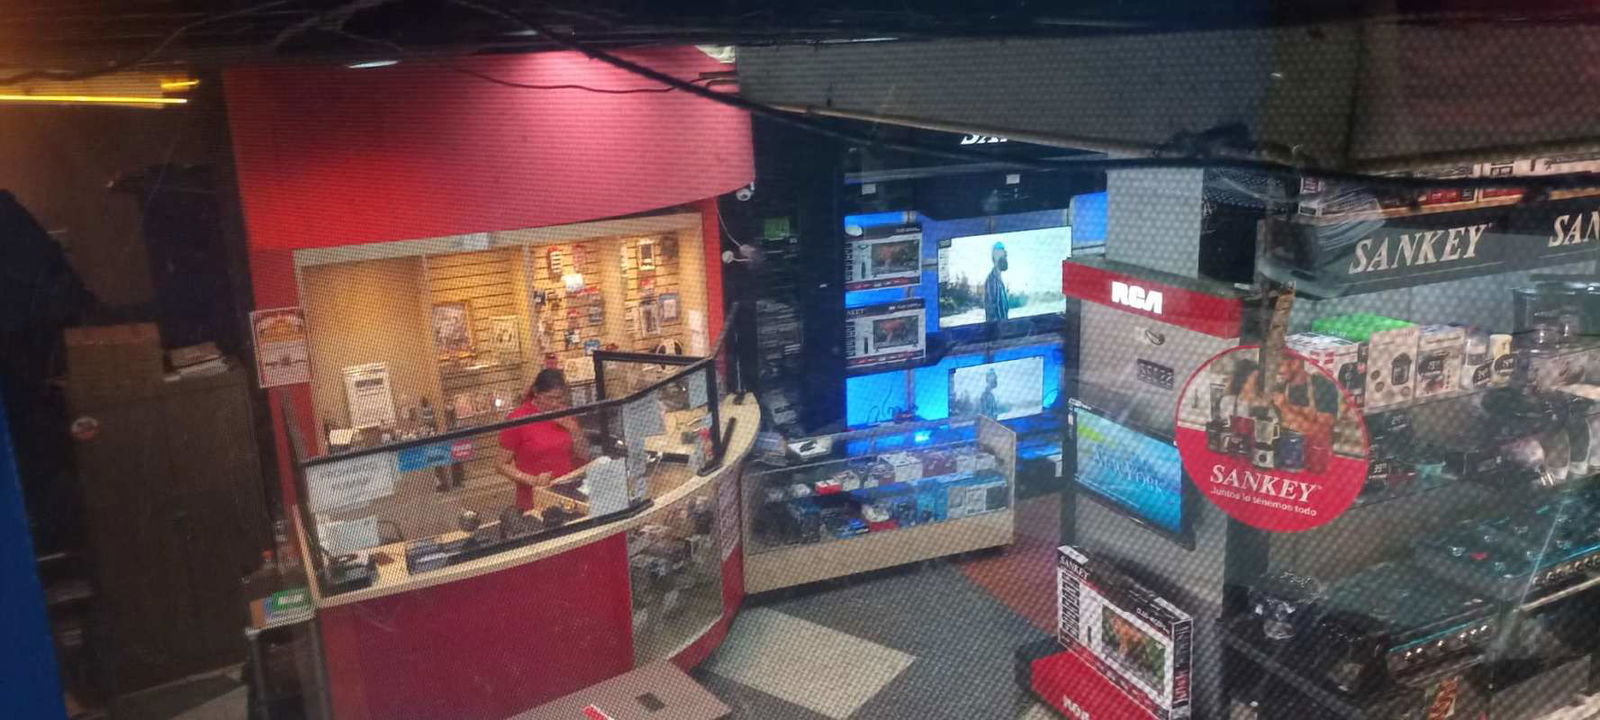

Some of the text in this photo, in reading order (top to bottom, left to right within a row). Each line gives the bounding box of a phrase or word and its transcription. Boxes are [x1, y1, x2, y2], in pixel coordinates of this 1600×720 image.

[1349, 223, 1486, 274] SANKEY
[1111, 280, 1164, 314] RCA
[1209, 463, 1317, 503] SANKEY
[1294, 506, 1318, 517] todo
[1059, 555, 1091, 580] SANKEY
